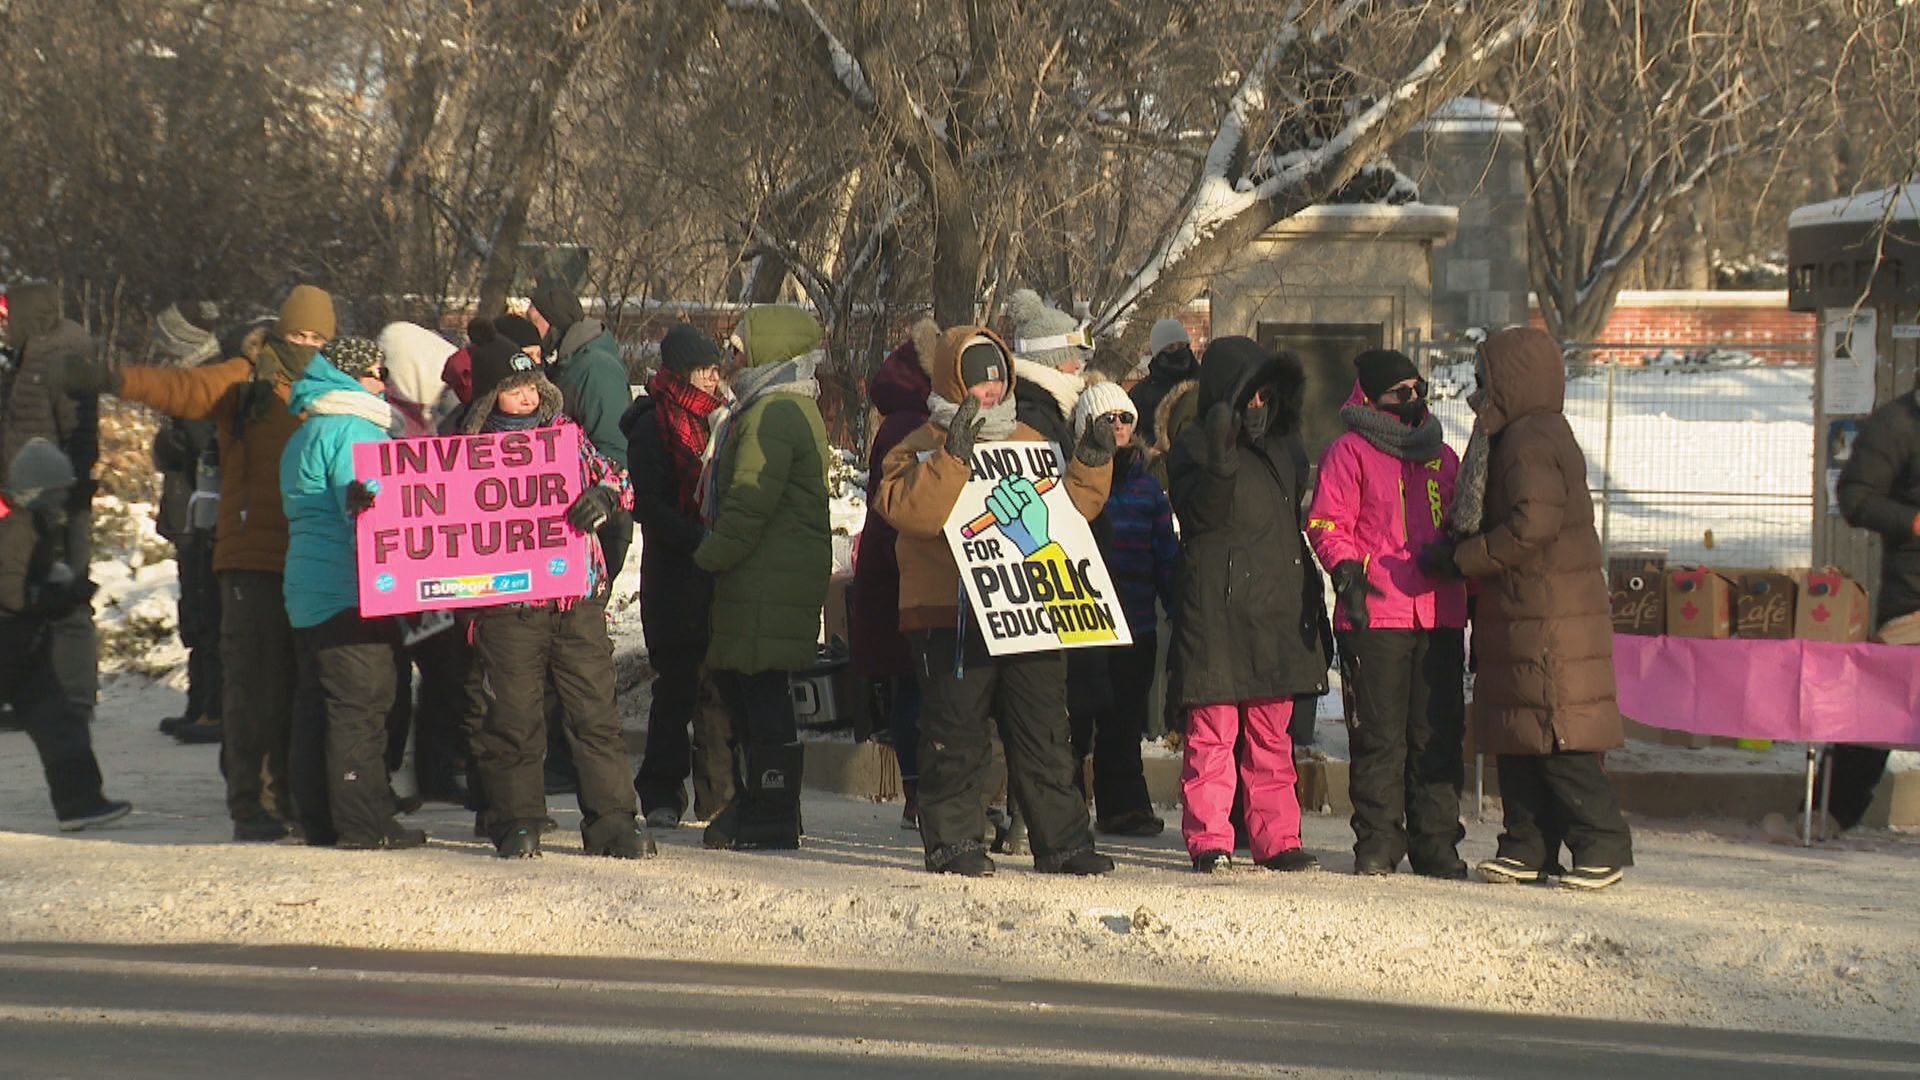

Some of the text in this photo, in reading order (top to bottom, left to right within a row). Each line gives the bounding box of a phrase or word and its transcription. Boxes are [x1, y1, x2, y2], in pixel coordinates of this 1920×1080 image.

[378, 429, 561, 476] INVEST
[968, 448, 1061, 482] AND UP
[401, 473, 569, 518] IN OUR
[374, 515, 567, 564] FUTURE
[962, 539, 1004, 562] FOR
[971, 558, 1102, 608] PUBLIC
[985, 602, 1116, 640] EDUCATION
[1738, 593, 1788, 632] Café
